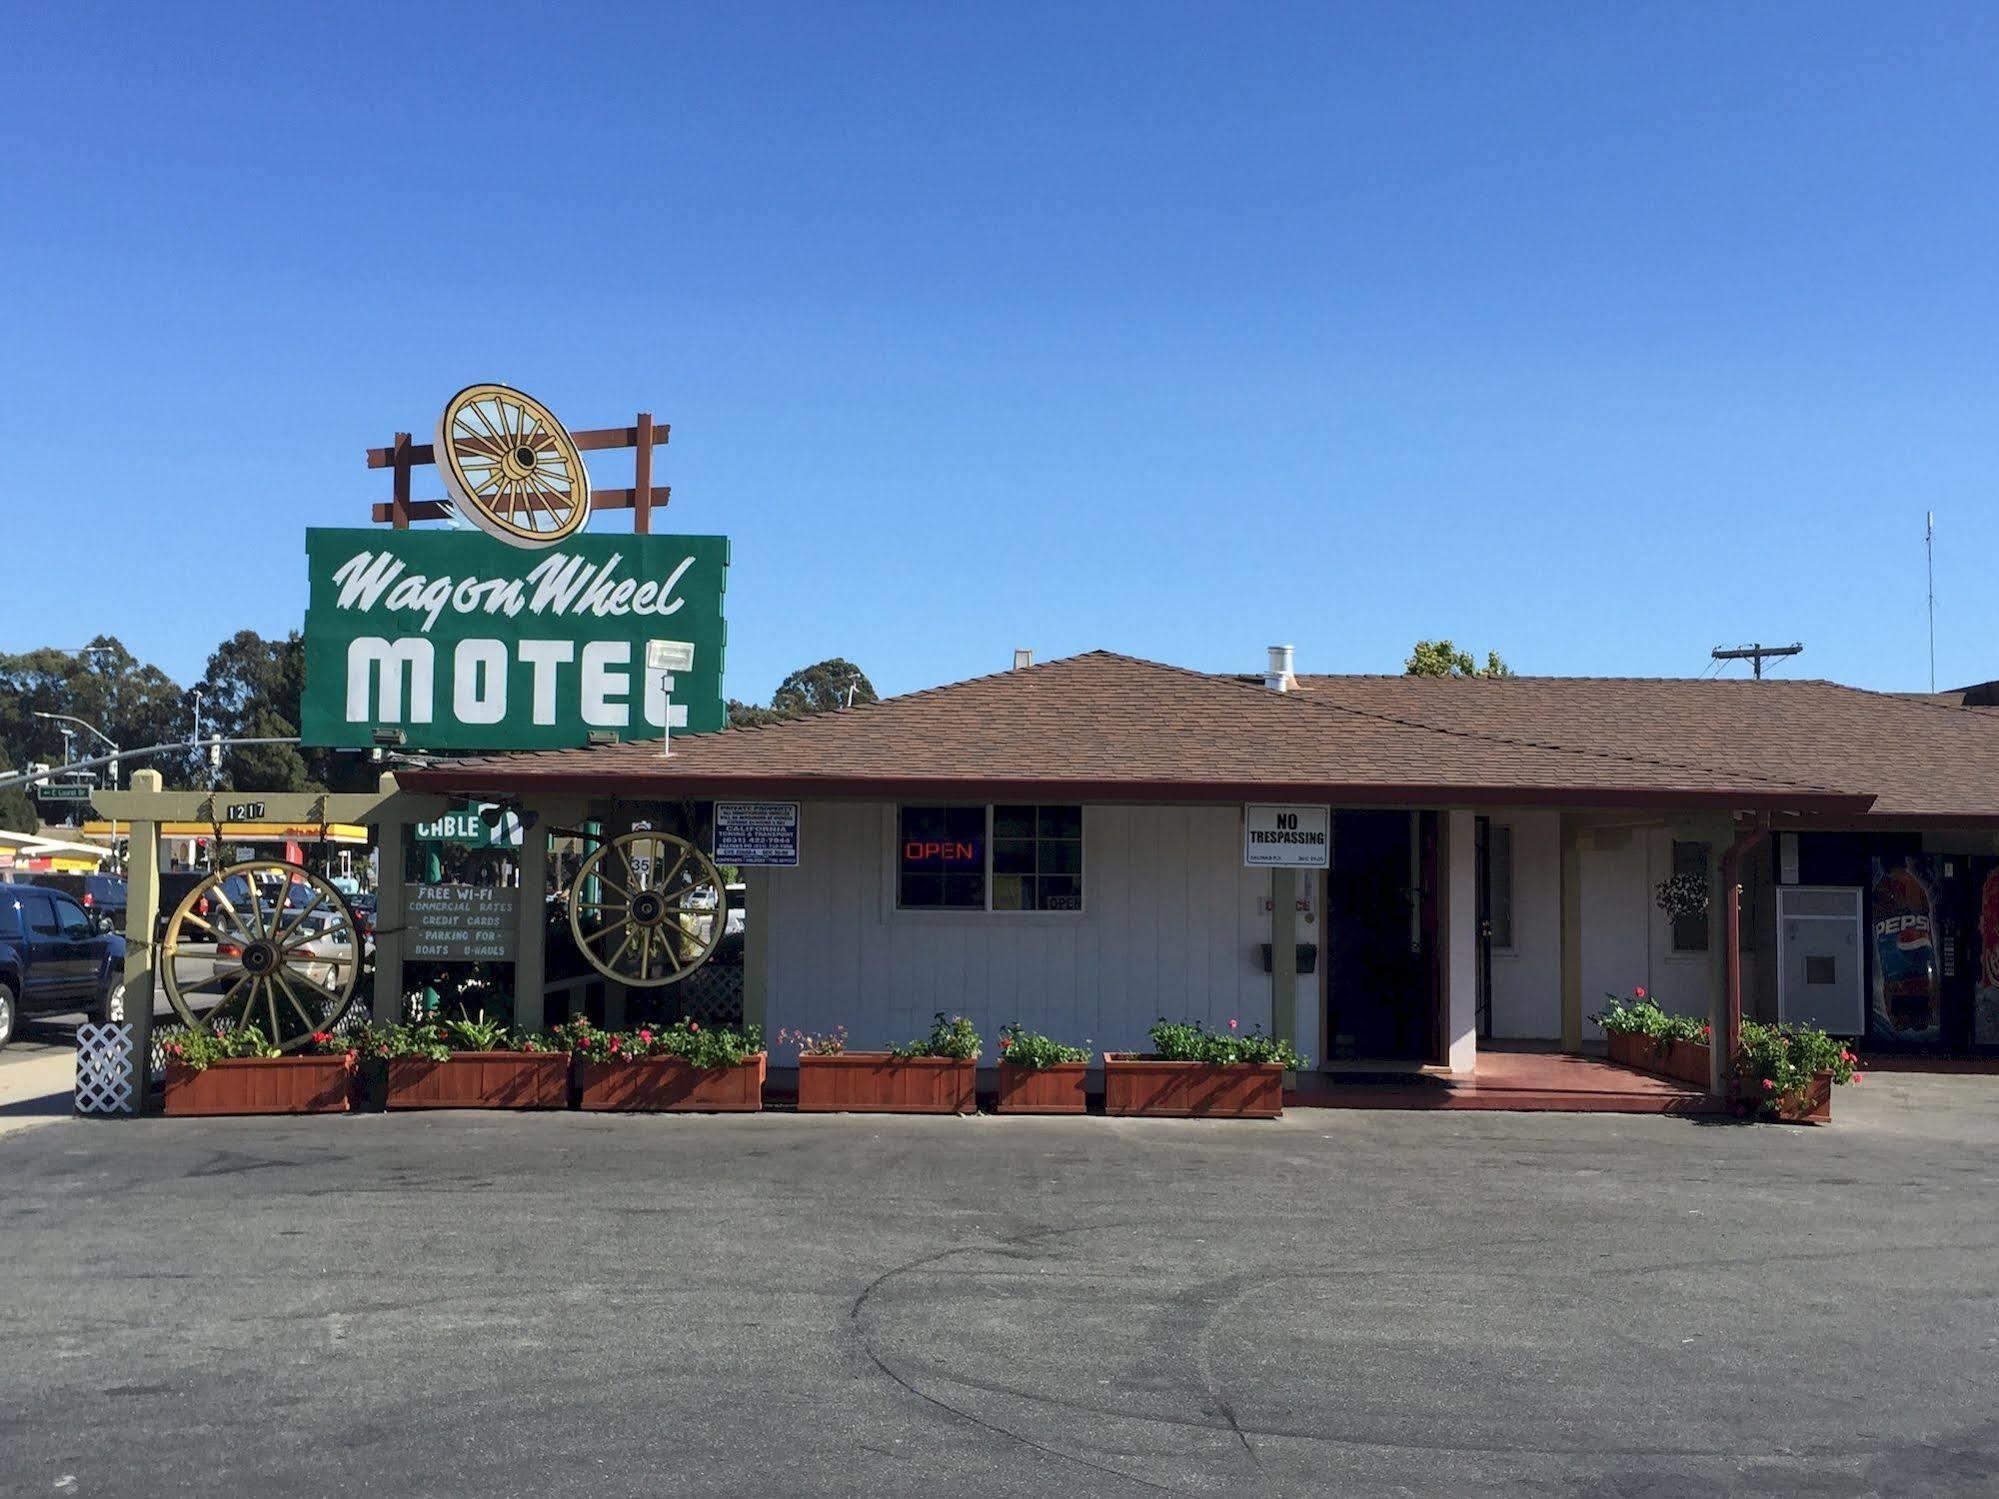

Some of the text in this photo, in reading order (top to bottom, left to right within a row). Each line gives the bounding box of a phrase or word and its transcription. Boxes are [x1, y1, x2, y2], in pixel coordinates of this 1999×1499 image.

[332, 550, 696, 632] Wagon Wheel
[346, 636, 689, 728] MOTEL
[229, 803, 265, 820] 1217
[1277, 813, 1298, 830] NO
[1250, 831, 1324, 845] TRESPASSING
[905, 842, 973, 860] OPEN
[631, 859, 649, 871] 35
[417, 887, 493, 901] FREE WI-FI
[409, 902, 513, 912] COMMERCIAL RATES
[422, 916, 501, 926] CREDIT CARDS
[415, 945, 449, 955] BOATS
